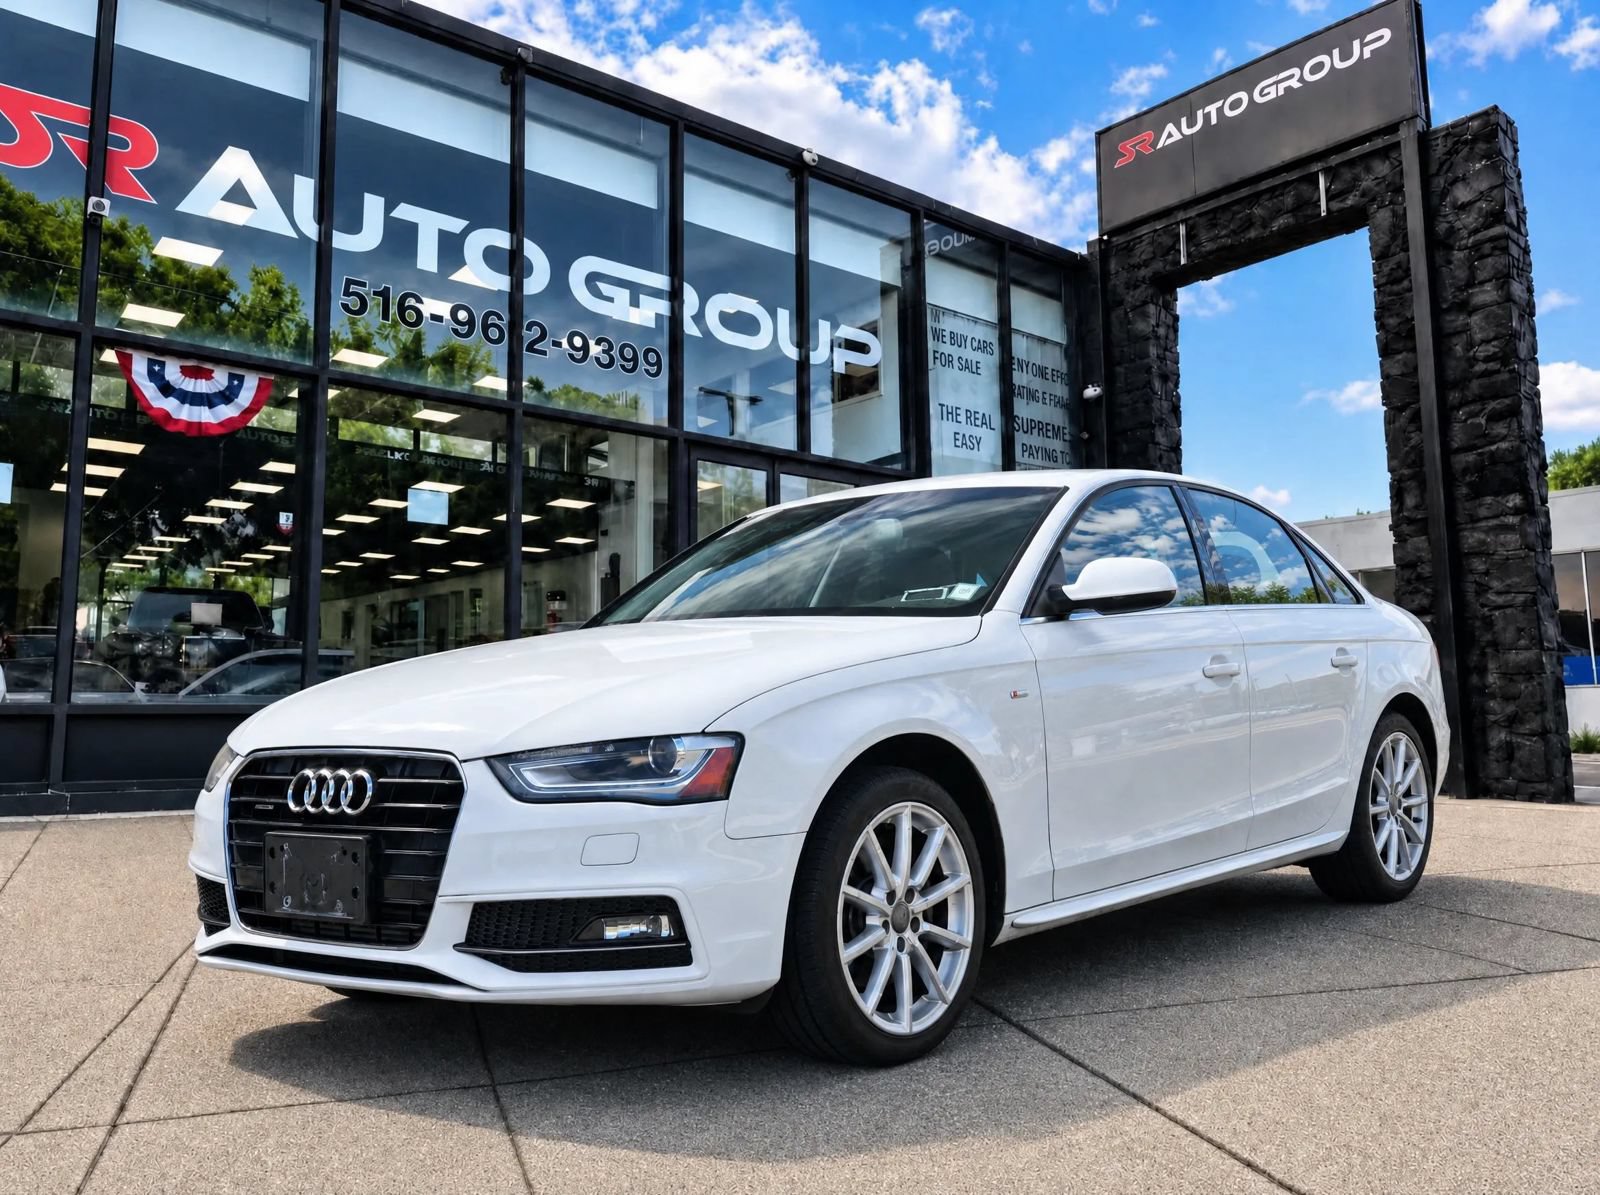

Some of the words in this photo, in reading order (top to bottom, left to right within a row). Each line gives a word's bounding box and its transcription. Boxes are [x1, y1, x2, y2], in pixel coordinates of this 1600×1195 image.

[1113, 130, 1155, 168] SR
[1156, 90, 1249, 150] AUTO
[1253, 27, 1392, 104] GROUP
[175, 145, 551, 296] AUTO
[568, 255, 883, 374] GROUP
[339, 275, 664, 379] 516-962-9399
[930, 326, 948, 345] WE
[949, 331, 969, 350] BUY
[970, 336, 995, 357] CARS
[932, 350, 955, 370] FOR
[957, 356, 982, 376] SALE
[1032, 363, 1050, 382] ONE
[938, 402, 962, 424] THE
[965, 408, 996, 431] REAL
[953, 431, 982, 452] EASY
[1021, 443, 1059, 464] PAYING
